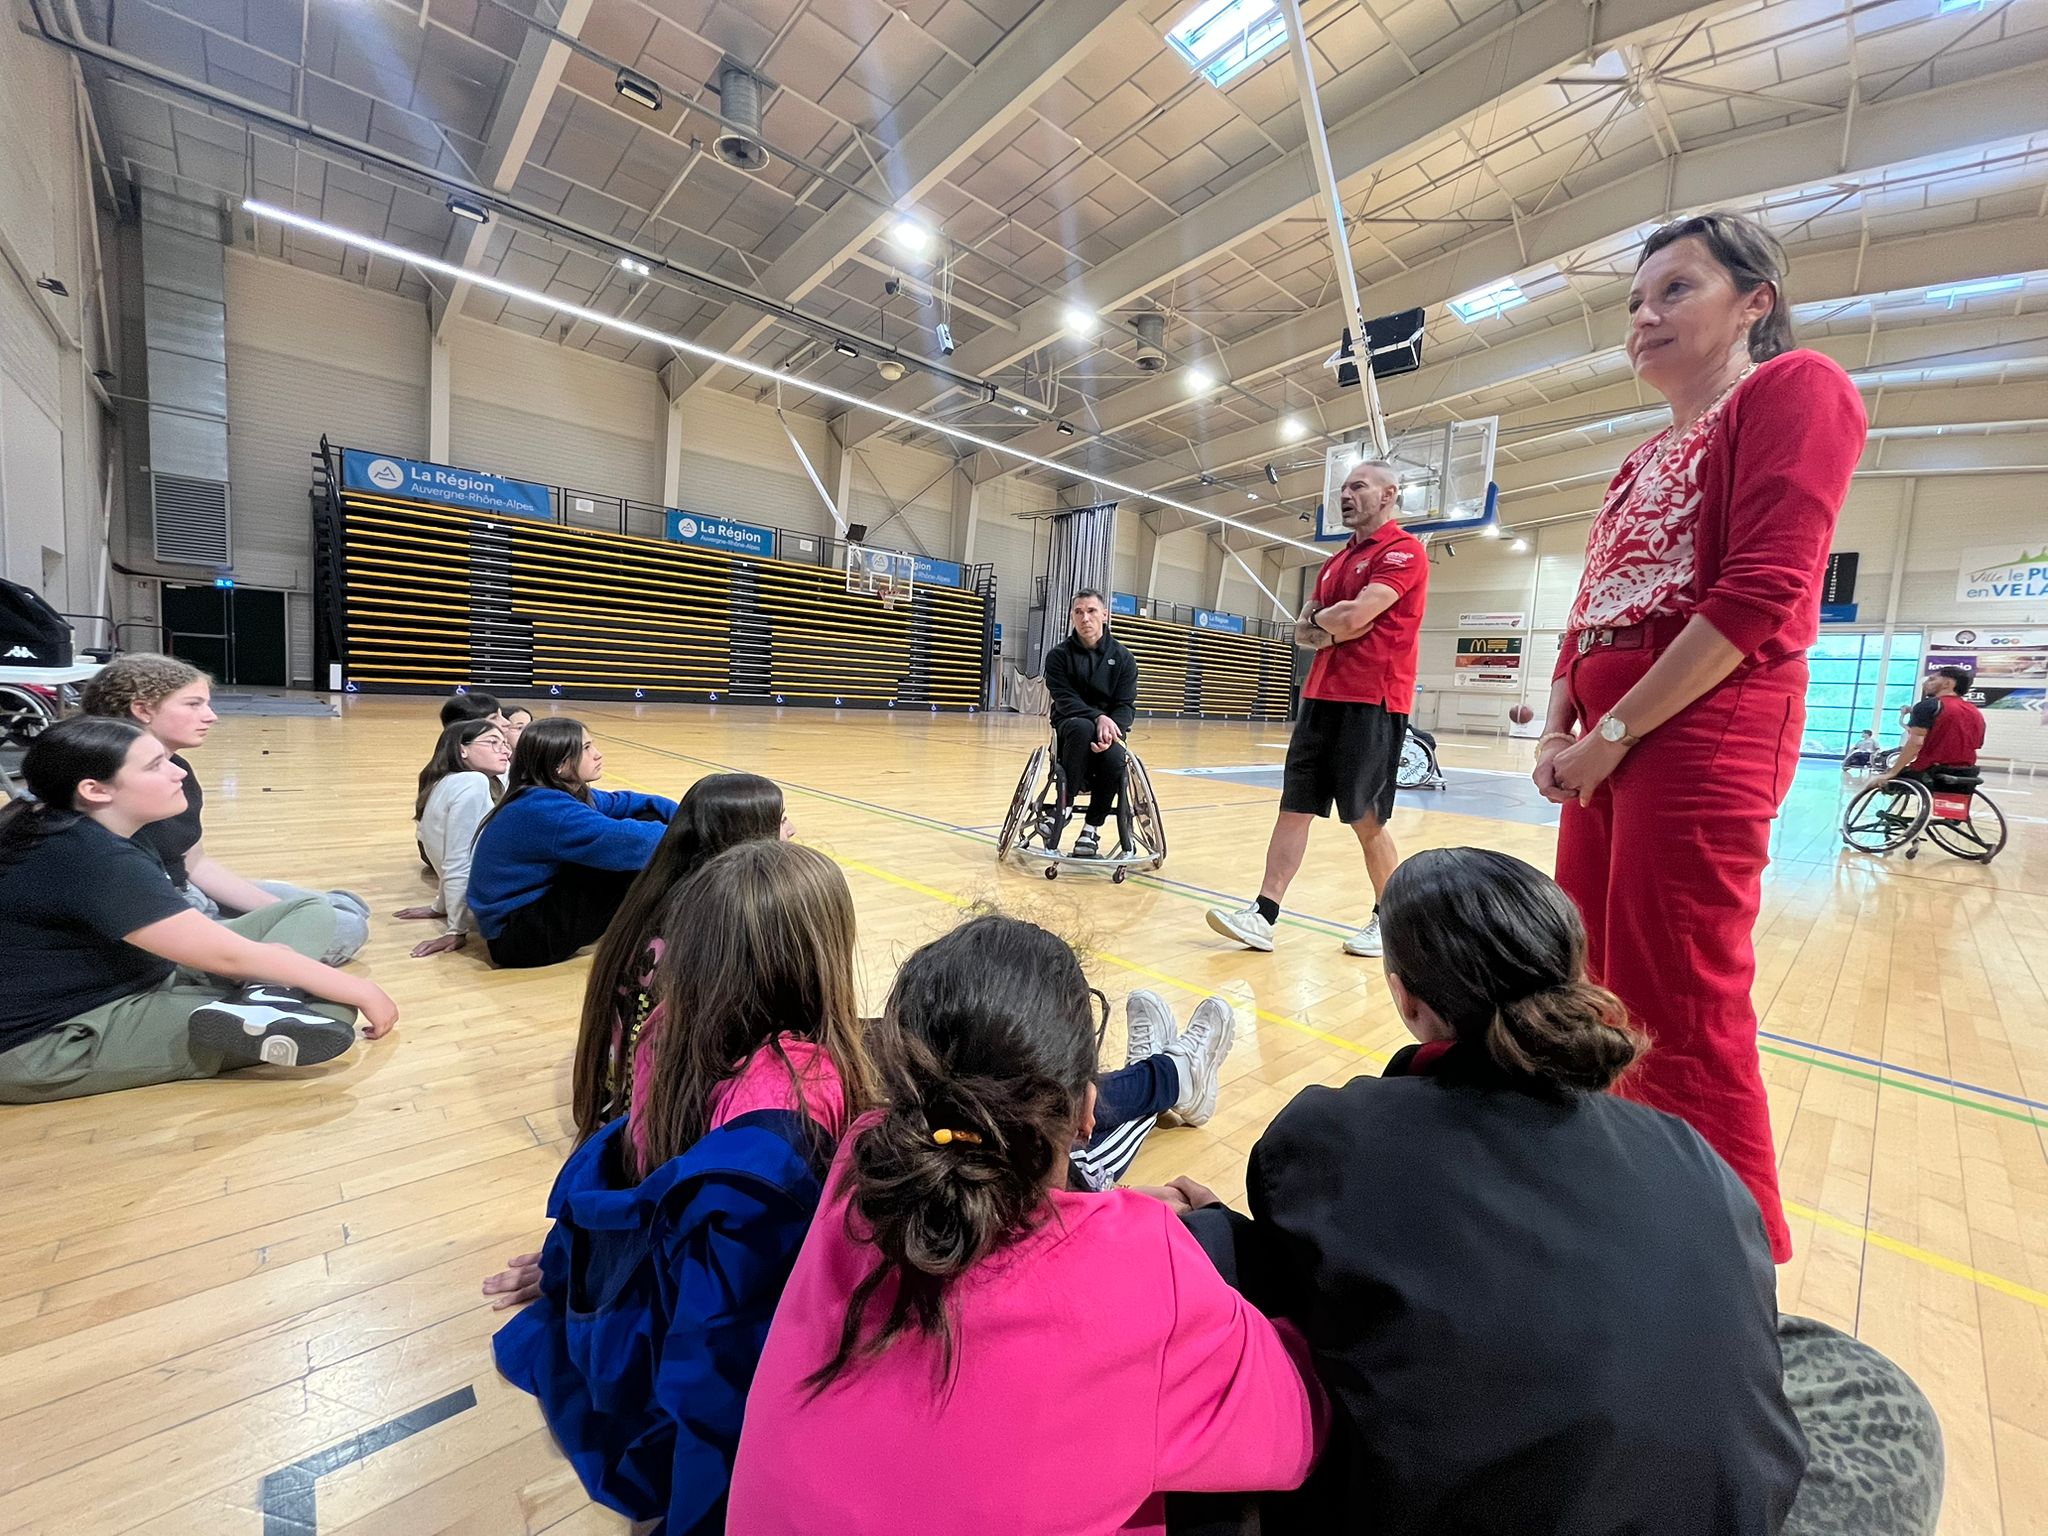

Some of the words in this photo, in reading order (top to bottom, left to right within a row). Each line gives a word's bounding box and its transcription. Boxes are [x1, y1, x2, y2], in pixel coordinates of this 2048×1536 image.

[411, 467, 431, 482] La
[436, 470, 495, 493] Région
[411, 483, 534, 512] Auvergne-Rhône-Alpes
[700, 521, 715, 535] La
[718, 525, 761, 543] Région
[1970, 571, 2002, 583] Ville
[2008, 568, 2025, 581] le
[1966, 588, 1989, 598] en
[1992, 583, 2048, 597] VELA
